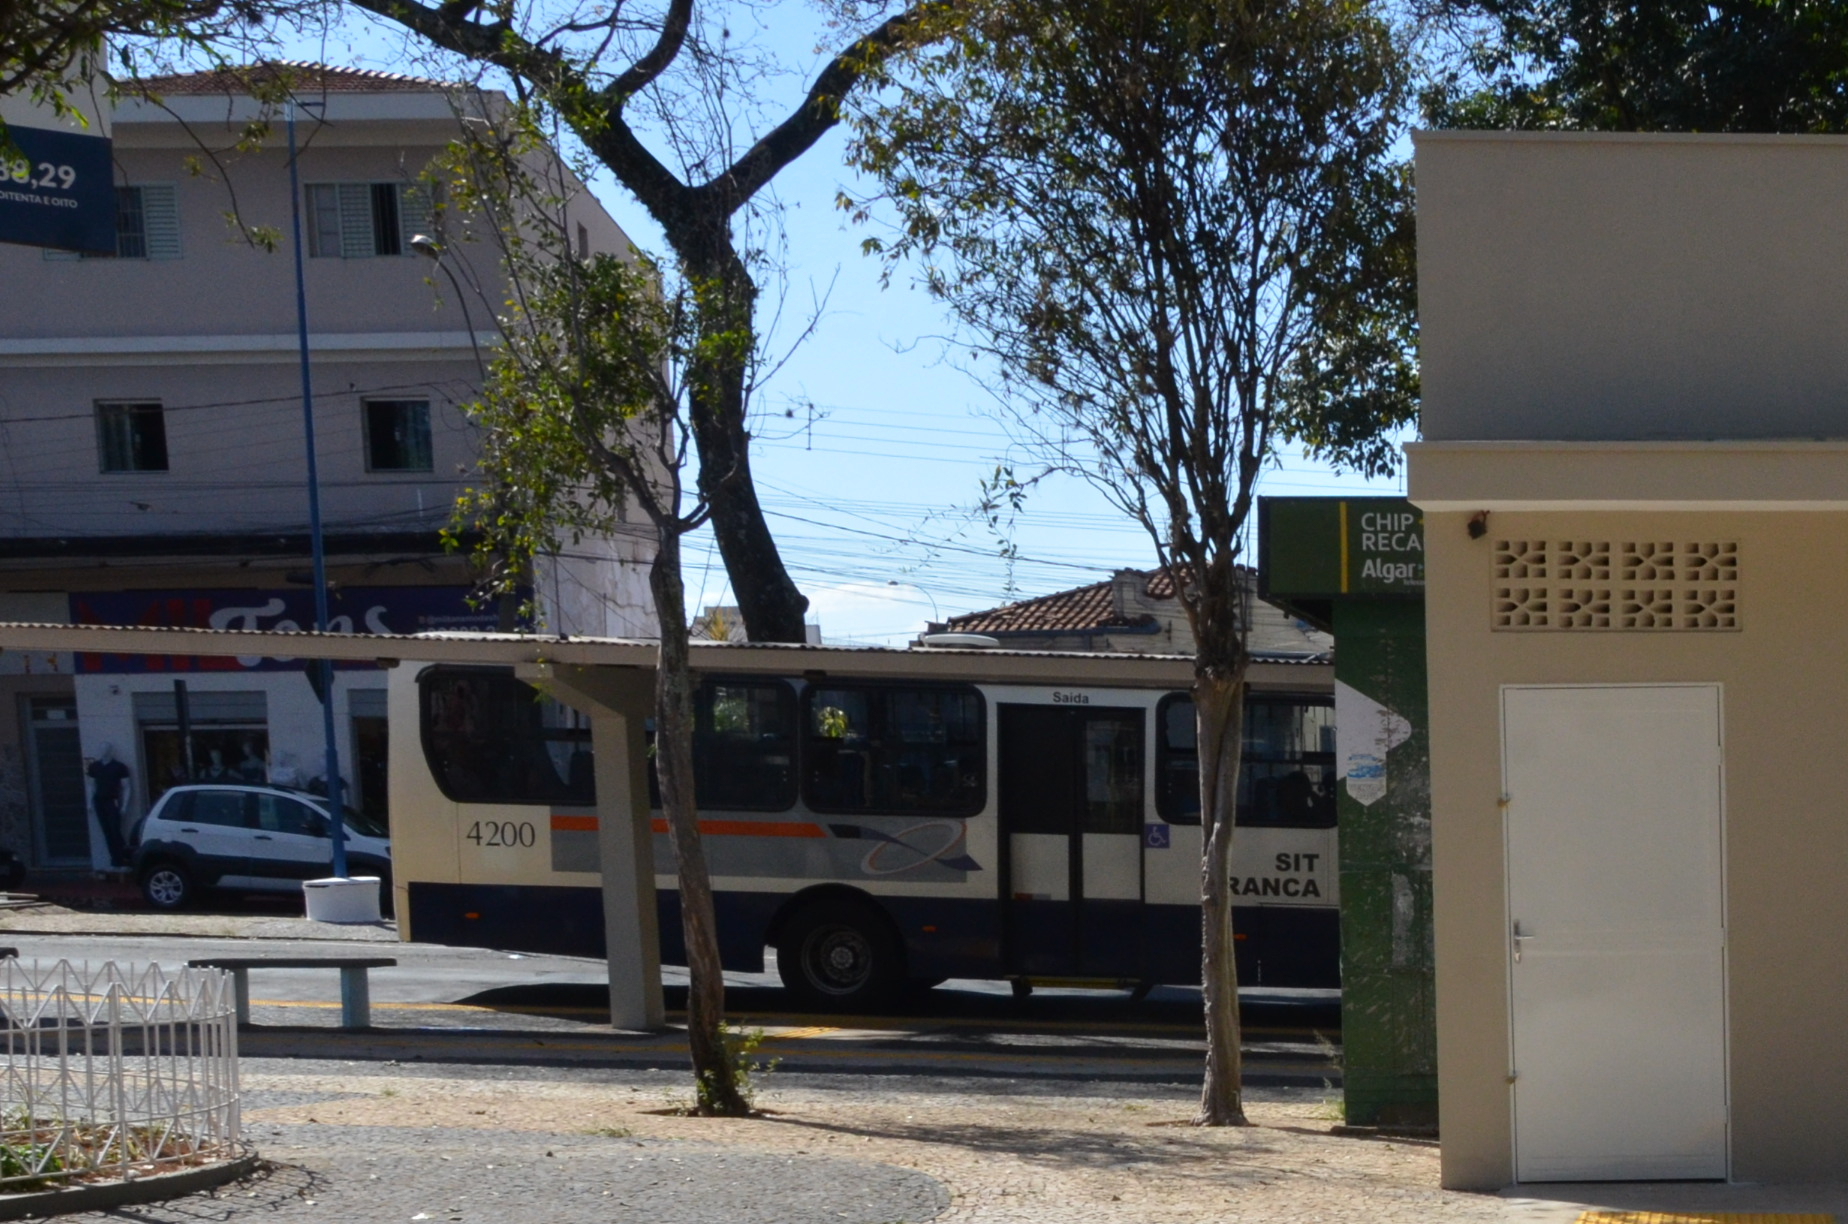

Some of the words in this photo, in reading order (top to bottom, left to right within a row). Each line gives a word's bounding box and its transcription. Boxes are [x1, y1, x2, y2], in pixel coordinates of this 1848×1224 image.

[51, 197, 78, 209] OITO
[1361, 512, 1414, 531] CHIP
[1362, 533, 1422, 551] RECA
[1362, 558, 1416, 583] Algar
[466, 821, 536, 848] 4200
[1276, 853, 1320, 872] SIT
